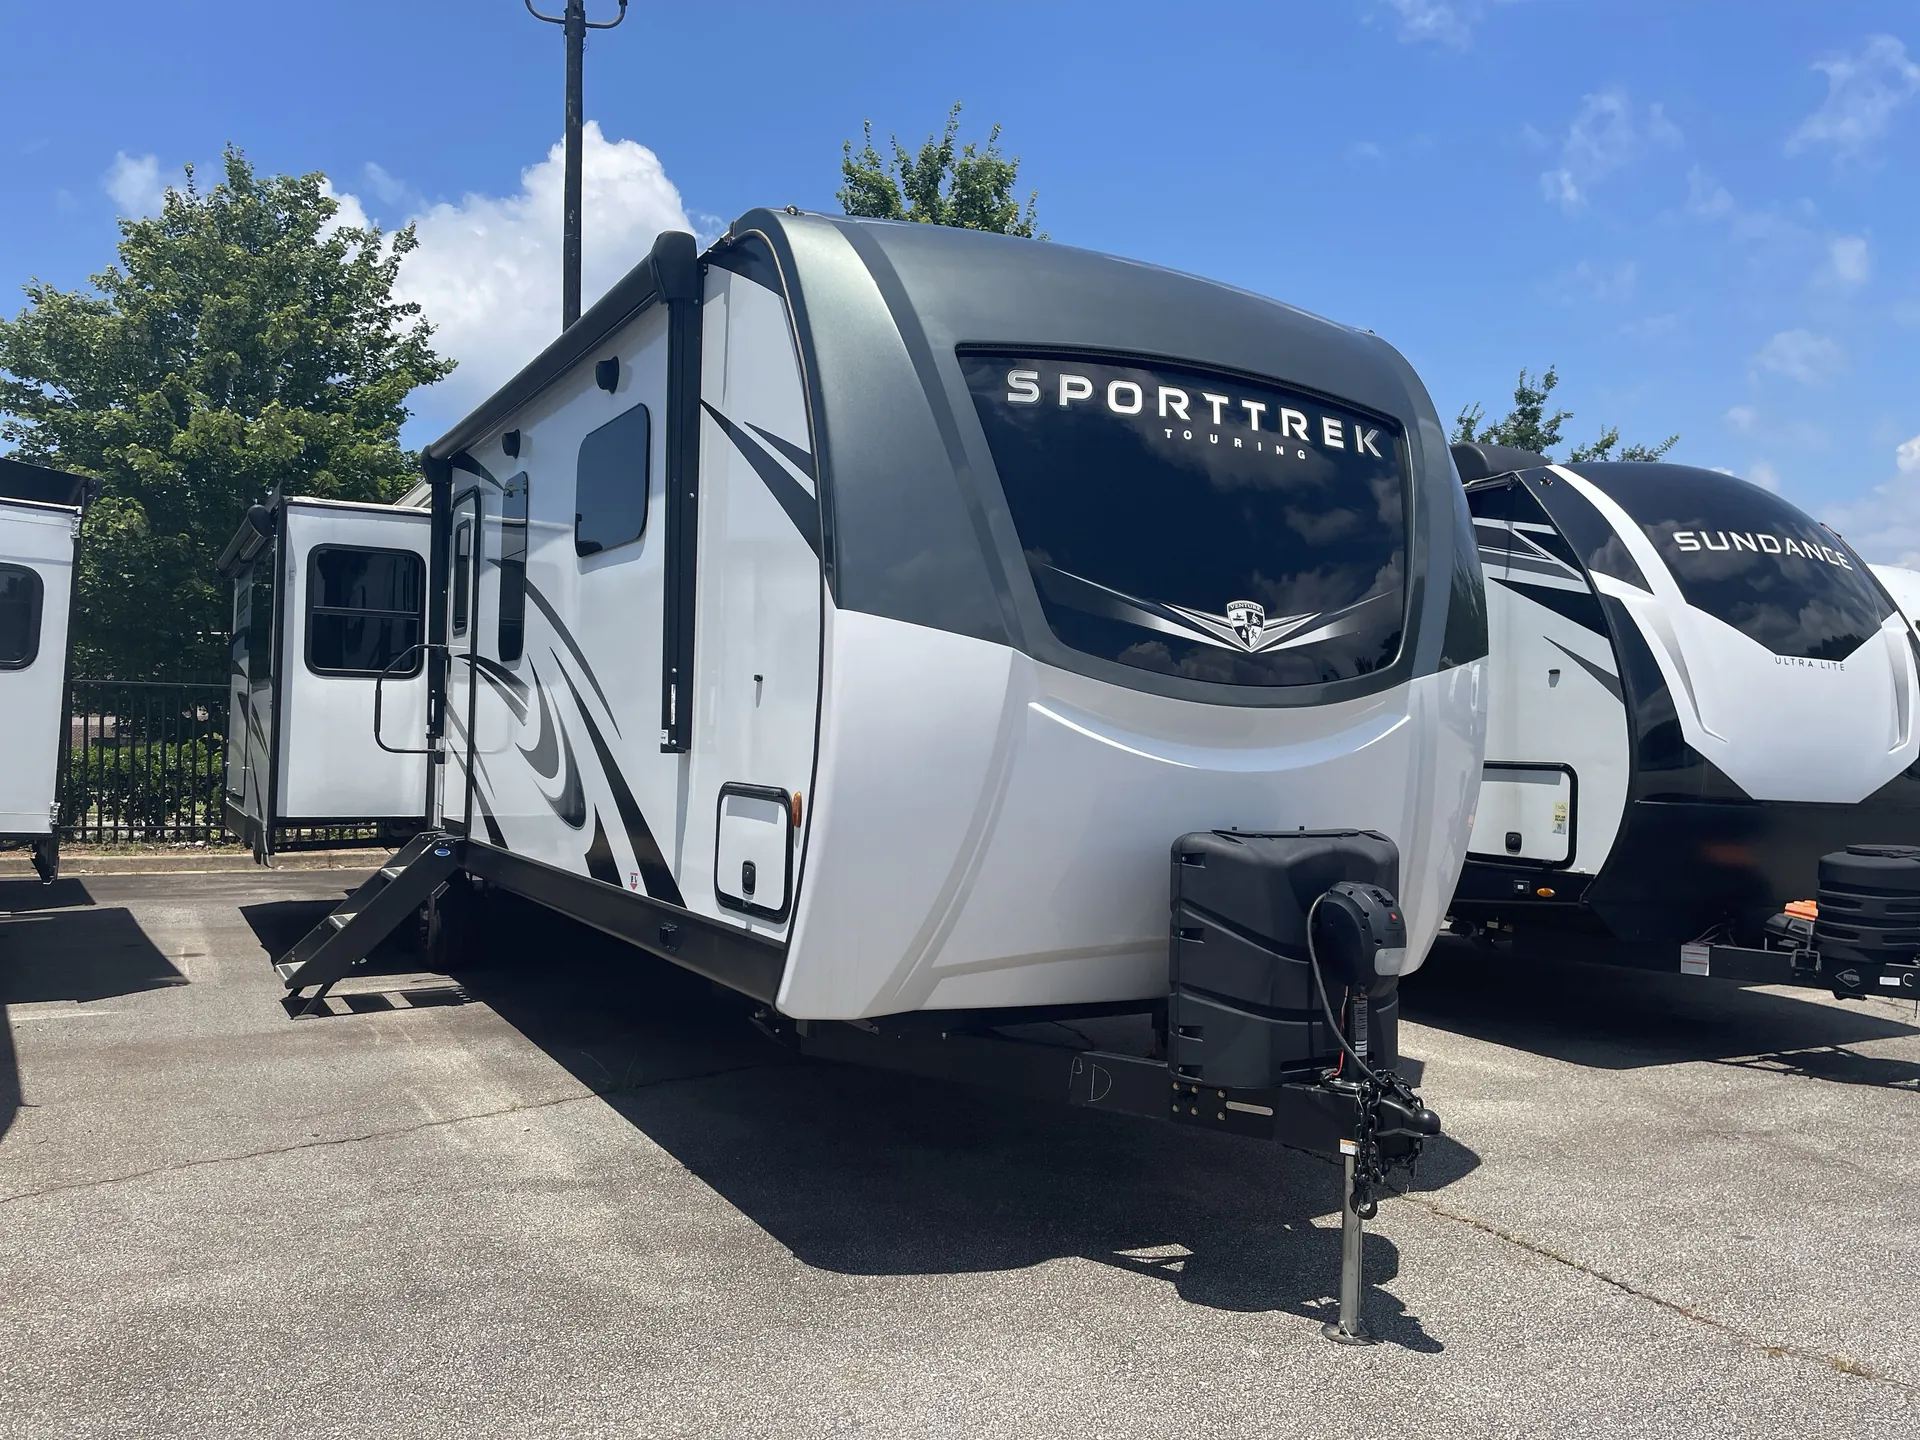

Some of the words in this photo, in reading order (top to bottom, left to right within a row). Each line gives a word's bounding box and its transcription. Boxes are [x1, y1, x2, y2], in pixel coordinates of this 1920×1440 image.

[1007, 369, 1382, 458] SPORTTREK
[1165, 428, 1306, 459] TOURING
[1673, 531, 1853, 570] SUNDANCE
[1774, 656, 1814, 668] ULTRA
[1820, 661, 1845, 671] LITE
